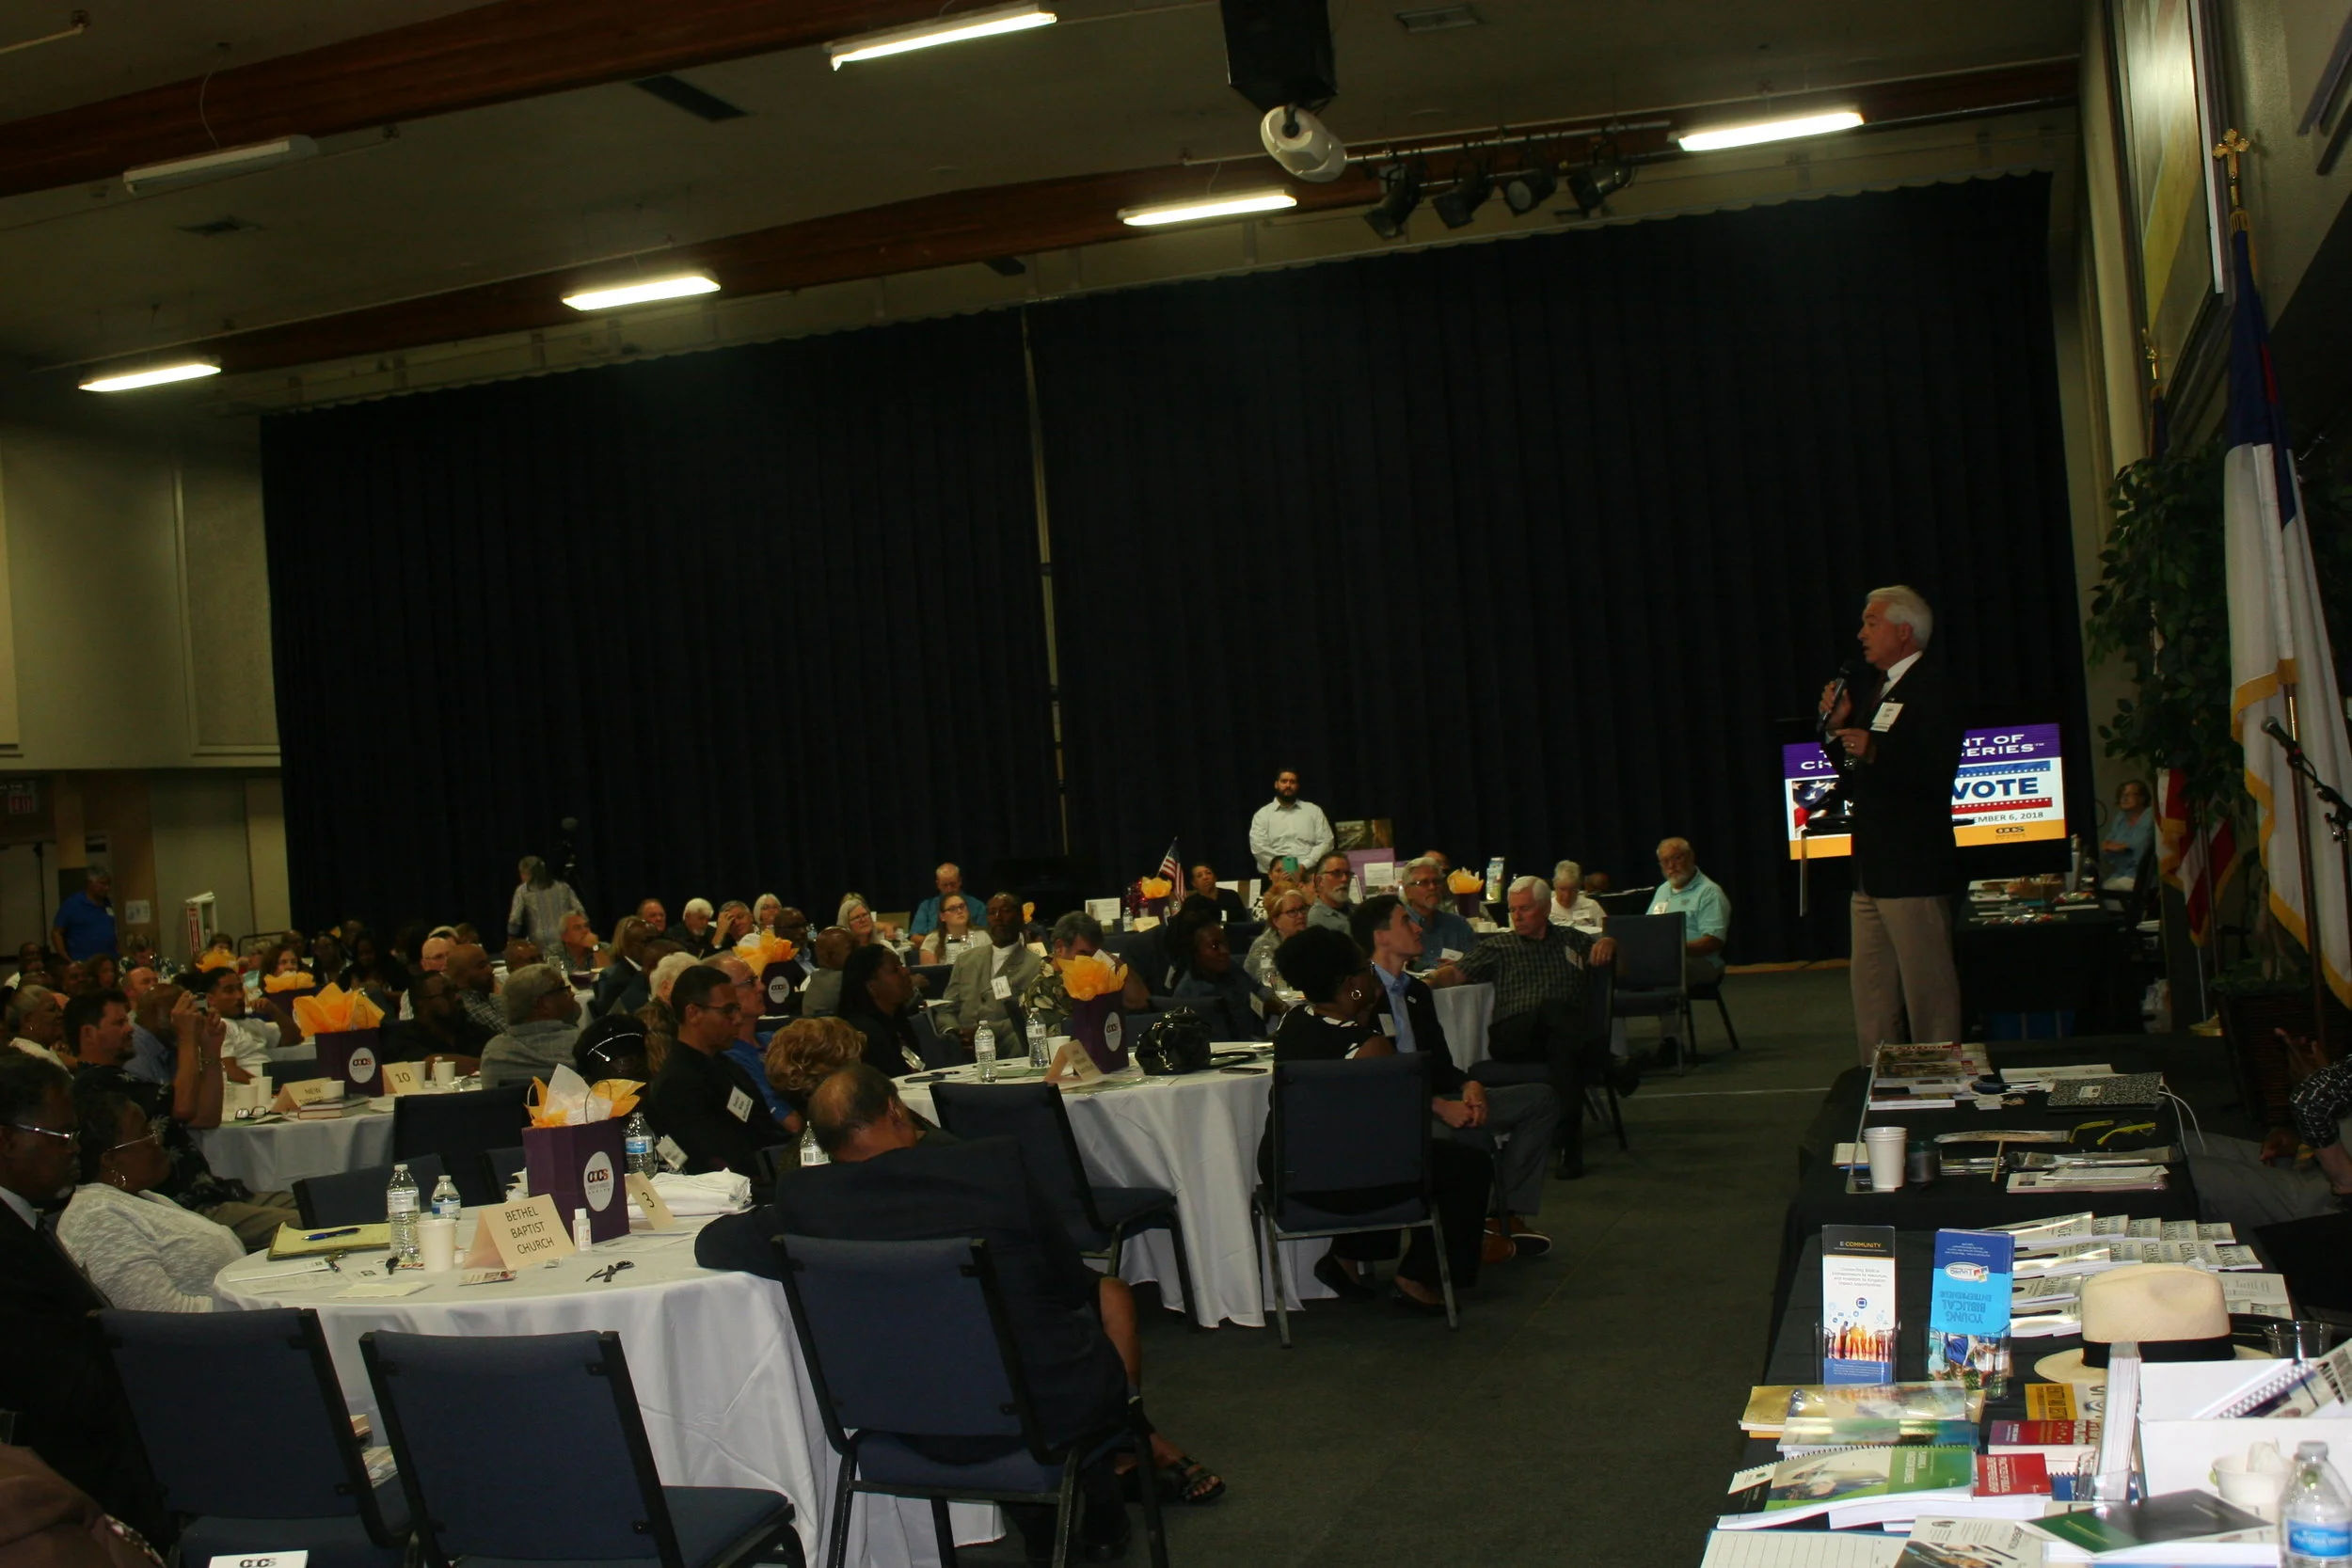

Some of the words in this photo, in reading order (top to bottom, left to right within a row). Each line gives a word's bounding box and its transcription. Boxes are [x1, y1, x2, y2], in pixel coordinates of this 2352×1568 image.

[1993, 734, 2025, 745] OF
[1961, 743, 2034, 757] ERIES
[1952, 777, 2039, 800] VOTE
[2021, 811, 2043, 820] 2018
[394, 1071, 411, 1084] 10
[642, 1192, 655, 1208] 3
[505, 1206, 539, 1222] BETHEL
[510, 1221, 545, 1239] BAPTIST
[516, 1237, 555, 1255] CHURCH
[1941, 1299, 1986, 1313] BIBLICAL
[1946, 1311, 1983, 1324] YOUNG
